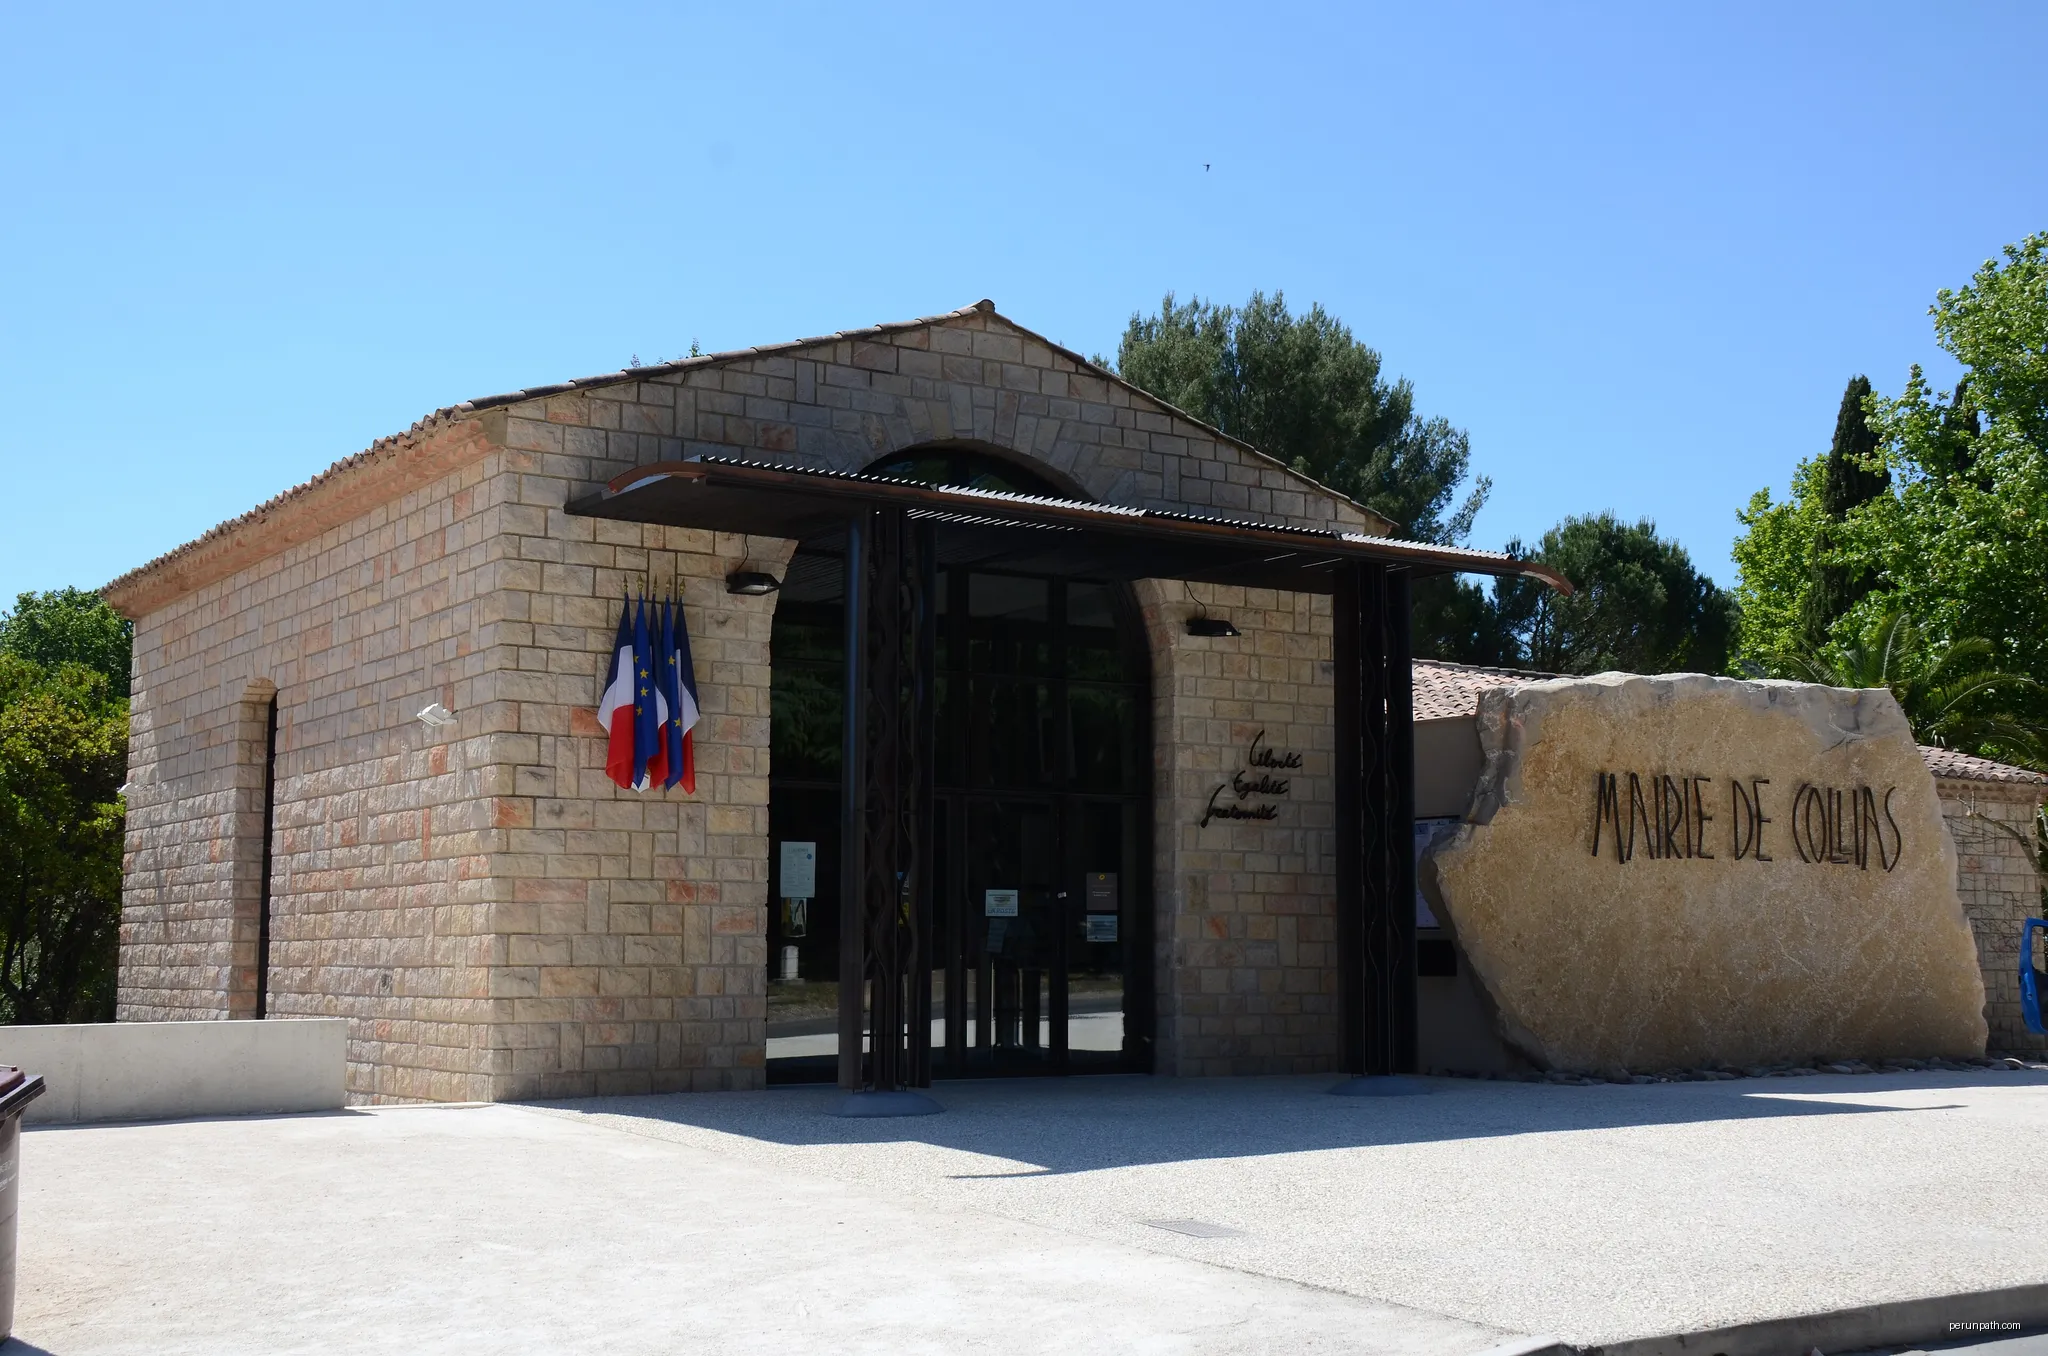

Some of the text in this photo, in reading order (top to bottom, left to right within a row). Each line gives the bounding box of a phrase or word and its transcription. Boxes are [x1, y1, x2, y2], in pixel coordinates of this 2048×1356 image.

[1249, 729, 1302, 768] Liberté
[1591, 772, 1902, 873] MAIRIE DE COLLIAS
